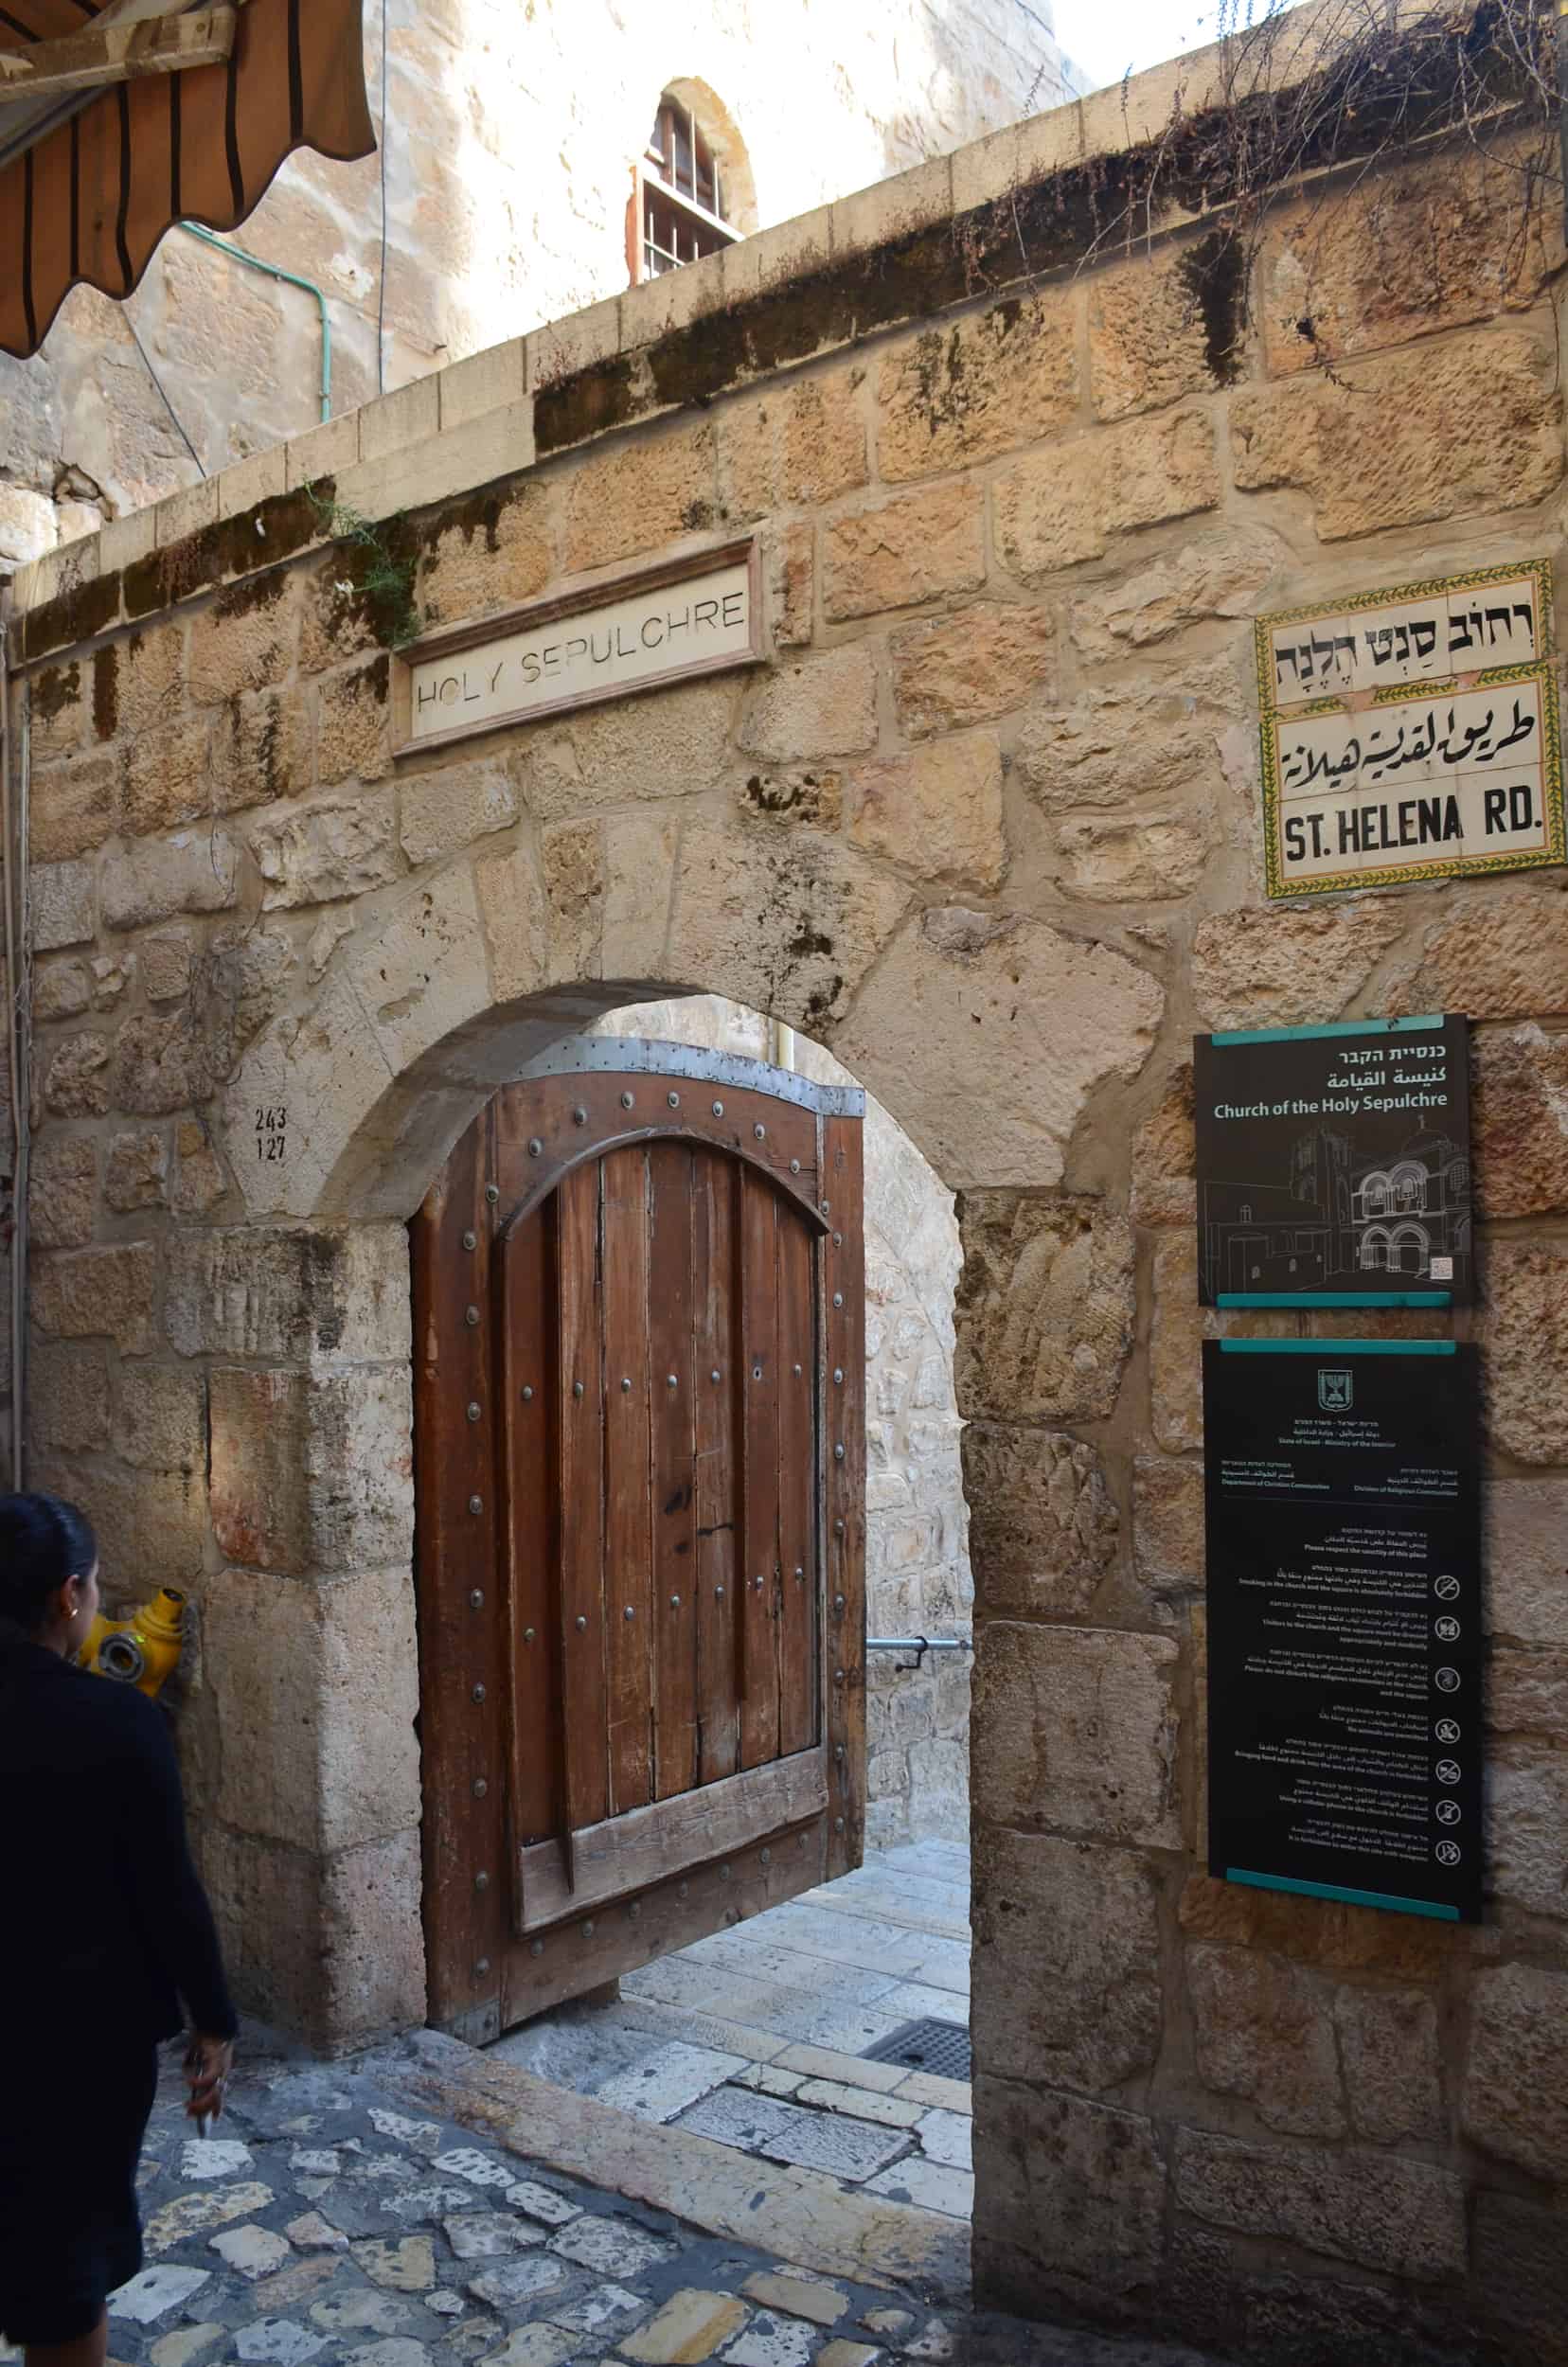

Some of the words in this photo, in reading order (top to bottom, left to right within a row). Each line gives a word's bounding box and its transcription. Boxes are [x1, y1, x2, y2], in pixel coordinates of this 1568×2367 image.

[418, 662, 504, 713] HOLY
[521, 592, 745, 684] SEPULCHRE
[1484, 785, 1543, 835] RD.
[1339, 1050, 1383, 1065] הקבר
[1388, 1045, 1446, 1061] כנסיית
[1327, 1071, 1385, 1091] القيامة
[1393, 1066, 1446, 1087] كنيسة
[1214, 1104, 1269, 1119] Church
[1273, 1101, 1290, 1115] of
[1292, 1099, 1319, 1114] the
[1322, 1096, 1360, 1114] Holy
[1363, 1092, 1448, 1112] Sepulchre
[255, 1107, 287, 1131] 243
[258, 1136, 285, 1161] 127
